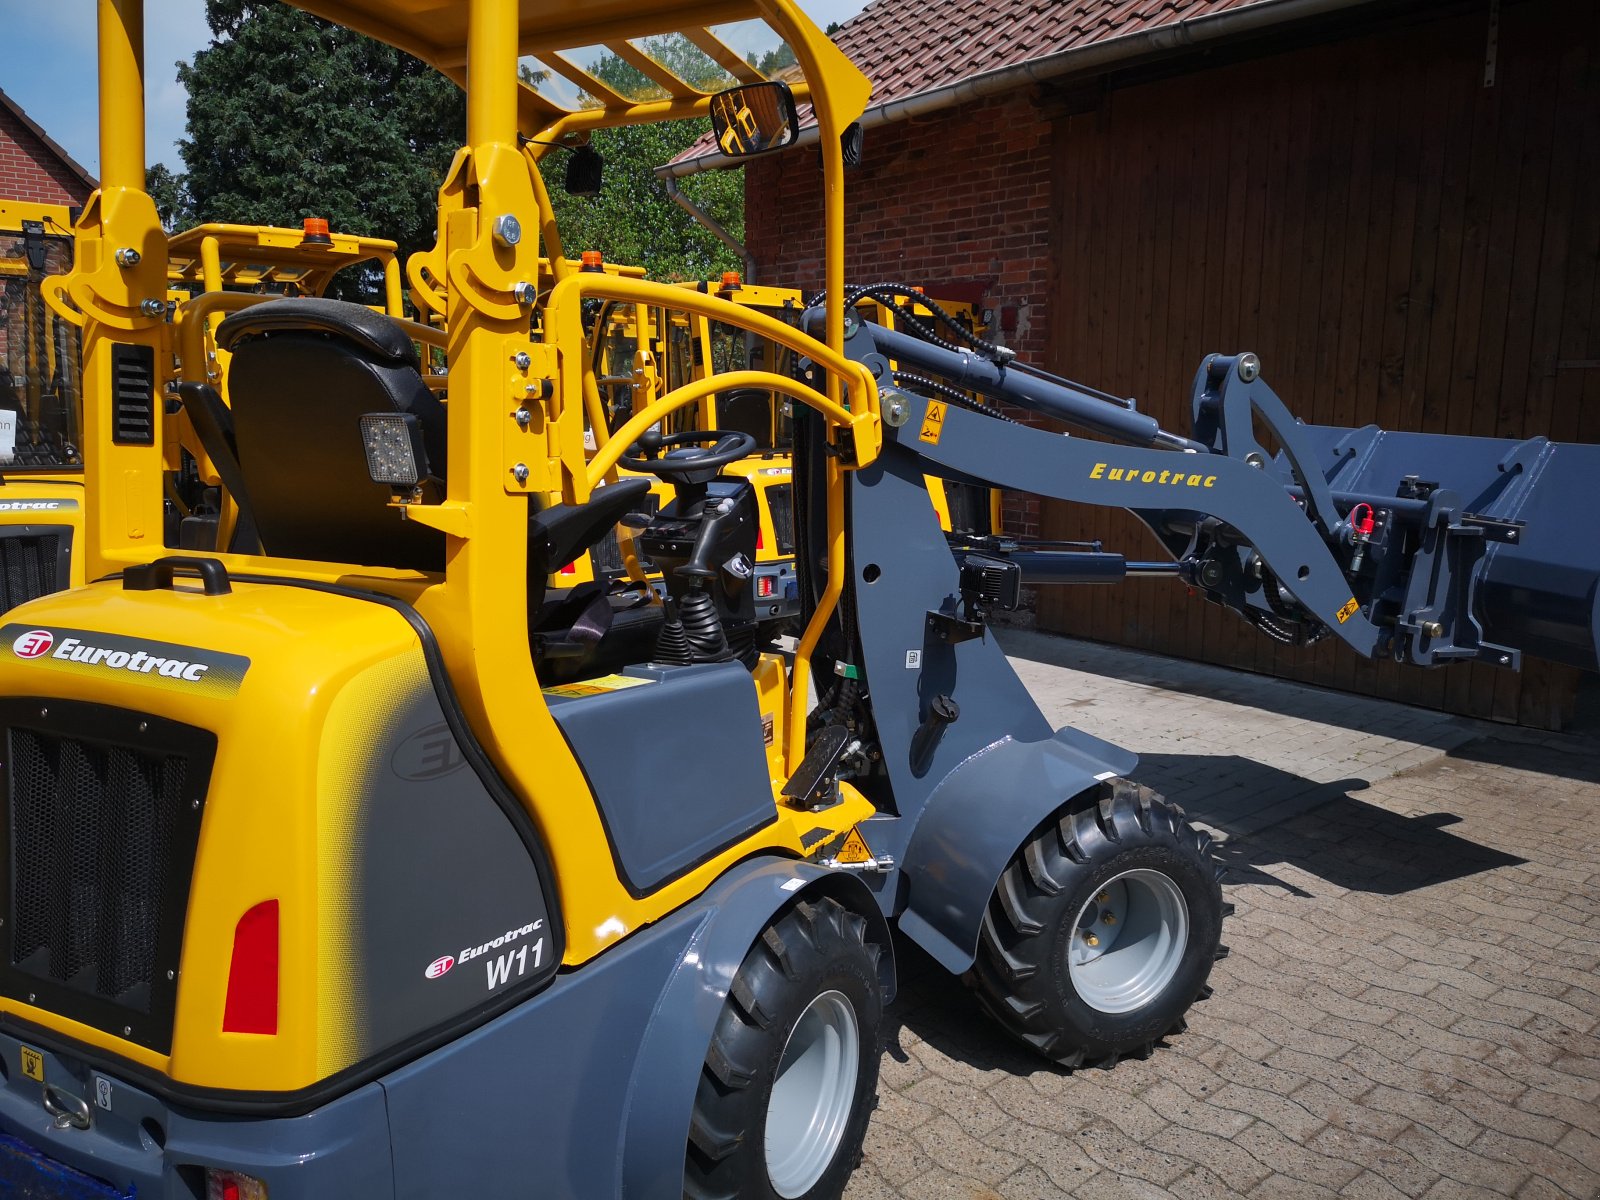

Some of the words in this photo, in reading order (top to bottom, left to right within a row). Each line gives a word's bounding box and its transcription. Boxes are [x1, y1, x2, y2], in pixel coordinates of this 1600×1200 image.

[1089, 462, 1217, 488] Eurotrac
[0, 502, 60, 510] otrac
[51, 637, 209, 681] Eurotrac
[457, 918, 543, 965] Eurotrac
[486, 937, 544, 991] W11
